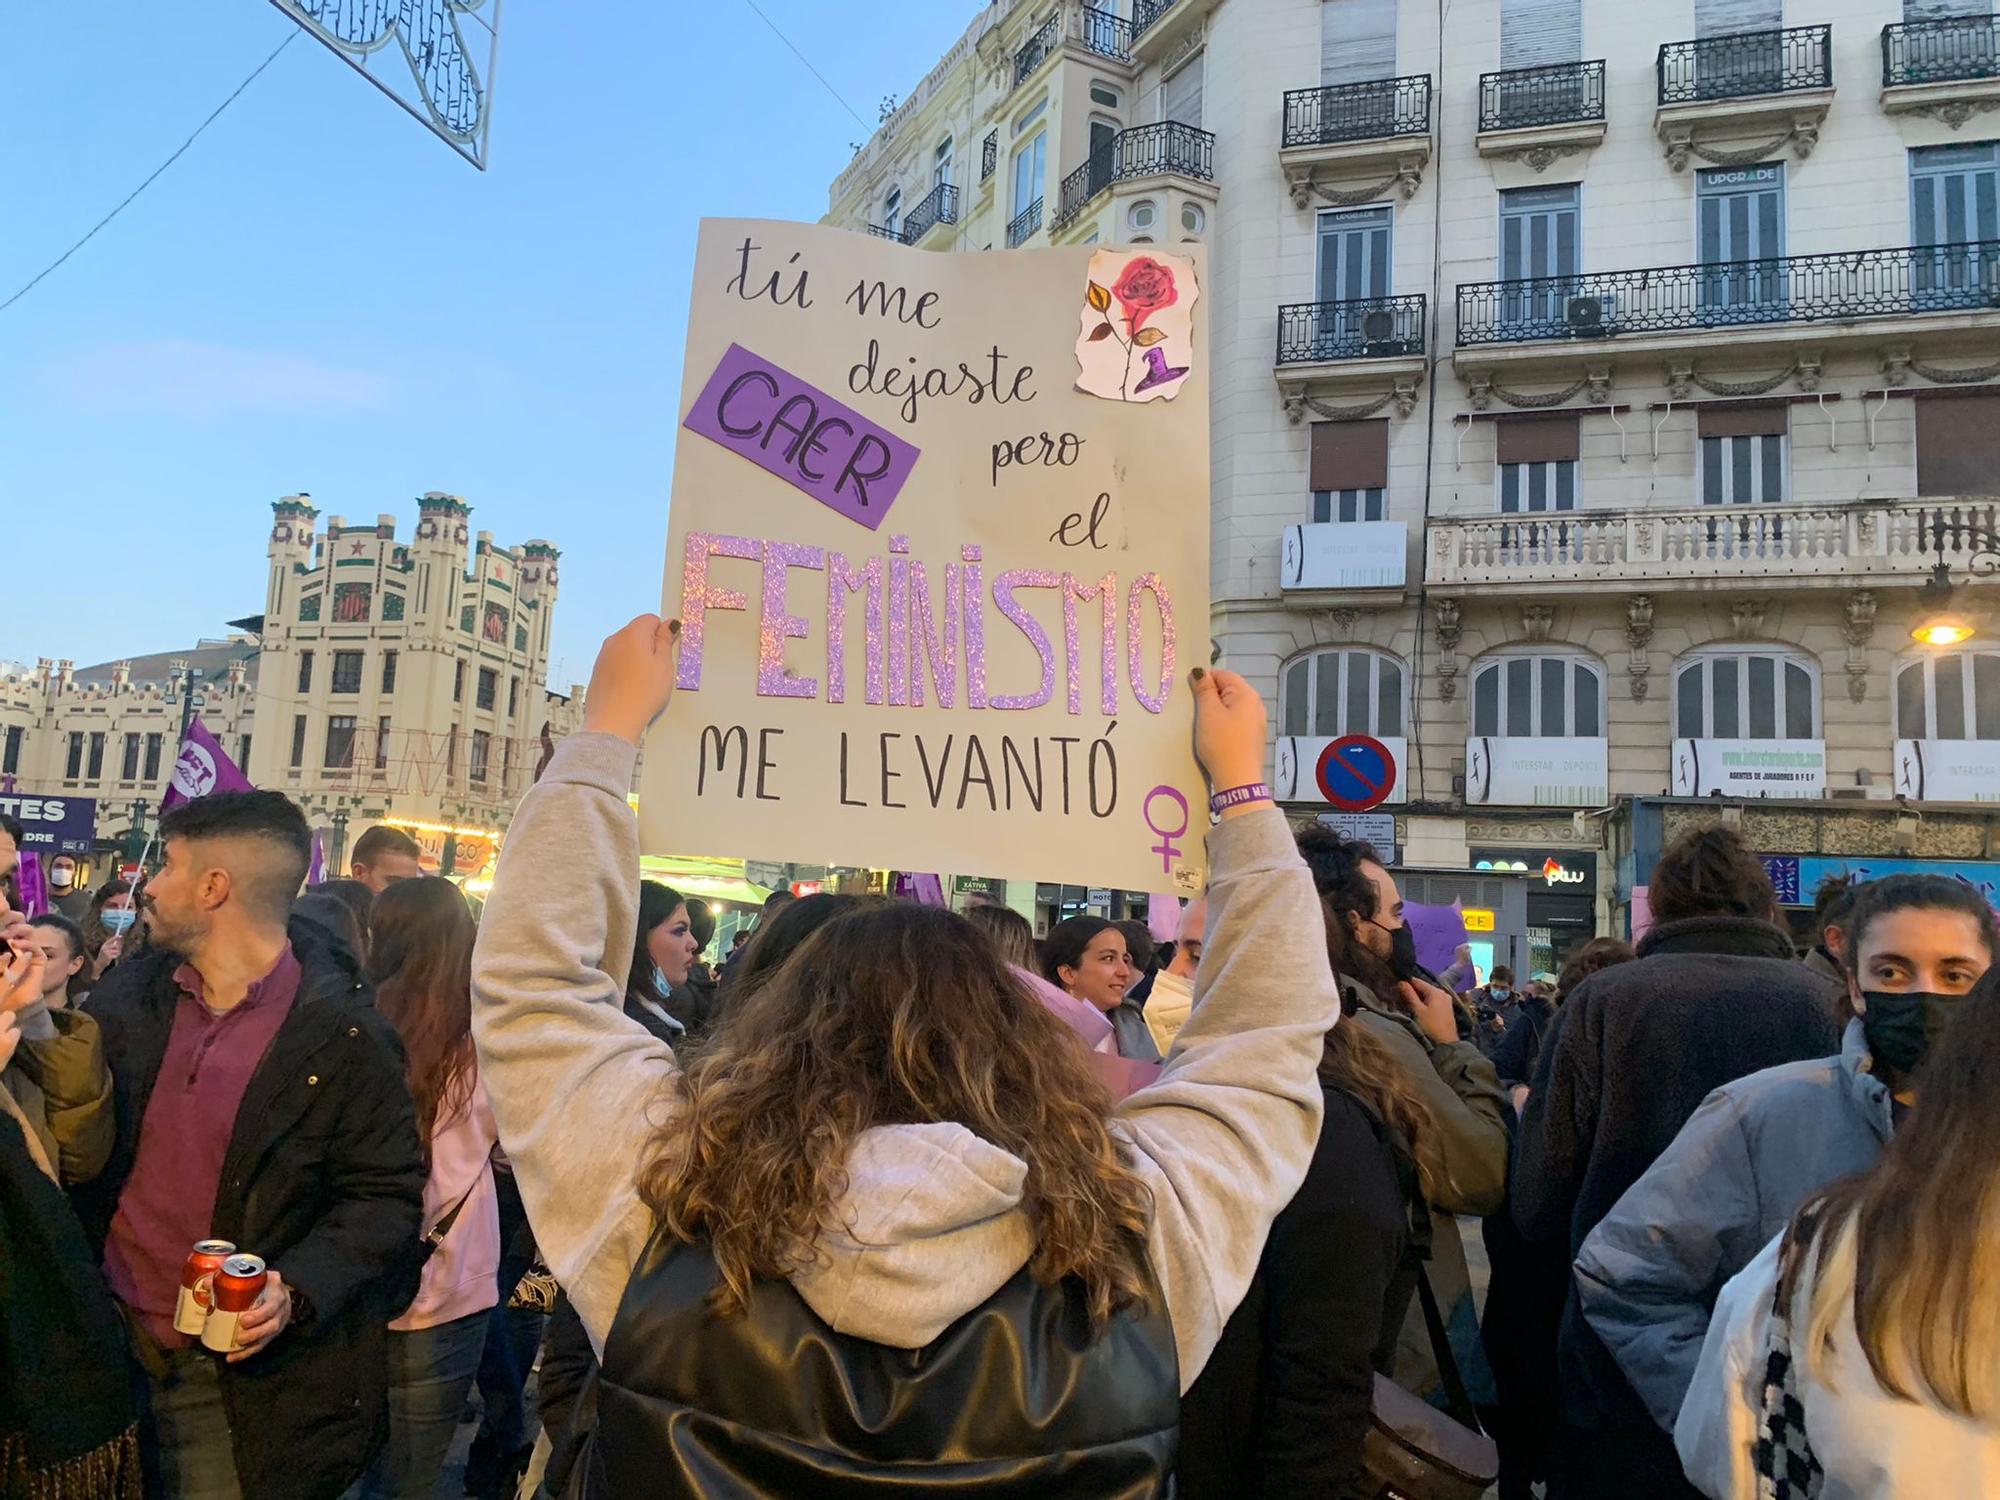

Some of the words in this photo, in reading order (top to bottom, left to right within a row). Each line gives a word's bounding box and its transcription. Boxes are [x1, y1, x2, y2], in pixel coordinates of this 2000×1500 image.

[1708, 169, 1775, 184] UPGRADE
[726, 238, 813, 309] tú
[845, 279, 941, 329] me
[848, 339, 1038, 424] dejaste
[716, 369, 893, 507] CAER
[991, 431, 1086, 487] pero
[1049, 492, 1111, 550] el
[697, 725, 784, 801] ME
[839, 720, 1118, 818] LEVANTÓ
